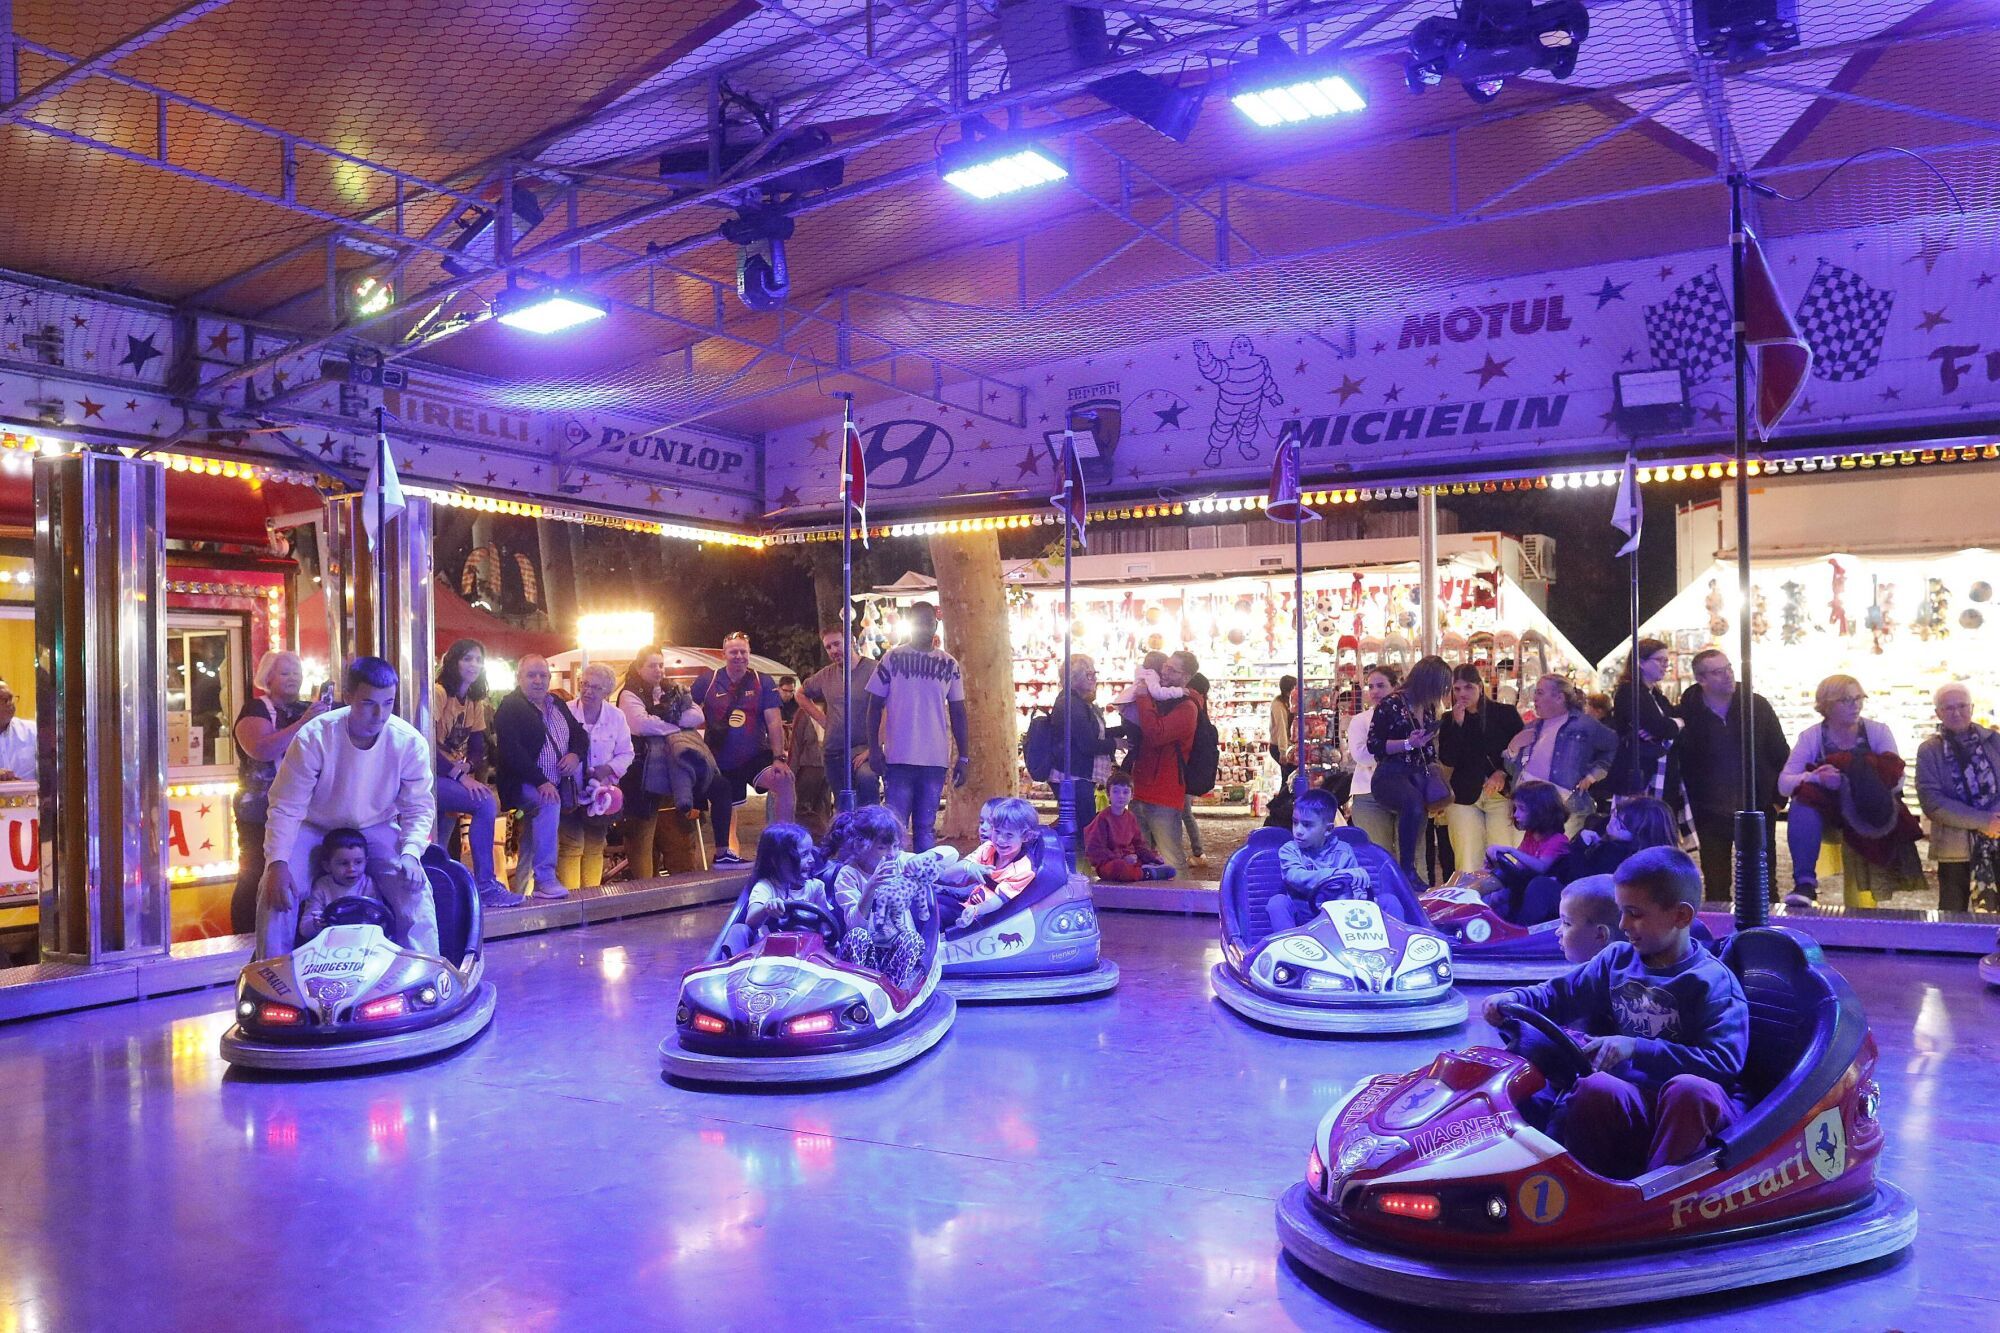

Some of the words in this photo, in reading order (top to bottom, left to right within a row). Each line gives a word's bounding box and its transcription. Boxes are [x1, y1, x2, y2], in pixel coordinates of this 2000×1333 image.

[1397, 295, 1572, 349] MOTUL
[1068, 381, 1120, 400] Ferrari
[1276, 395, 1569, 450] MICHELIN
[598, 426, 743, 474] DUNLOP
[1294, 941, 1319, 958] intel
[1345, 932, 1384, 942] BMW
[1533, 1180, 1550, 1219] 1
[1669, 1141, 1811, 1231] Ferrari
